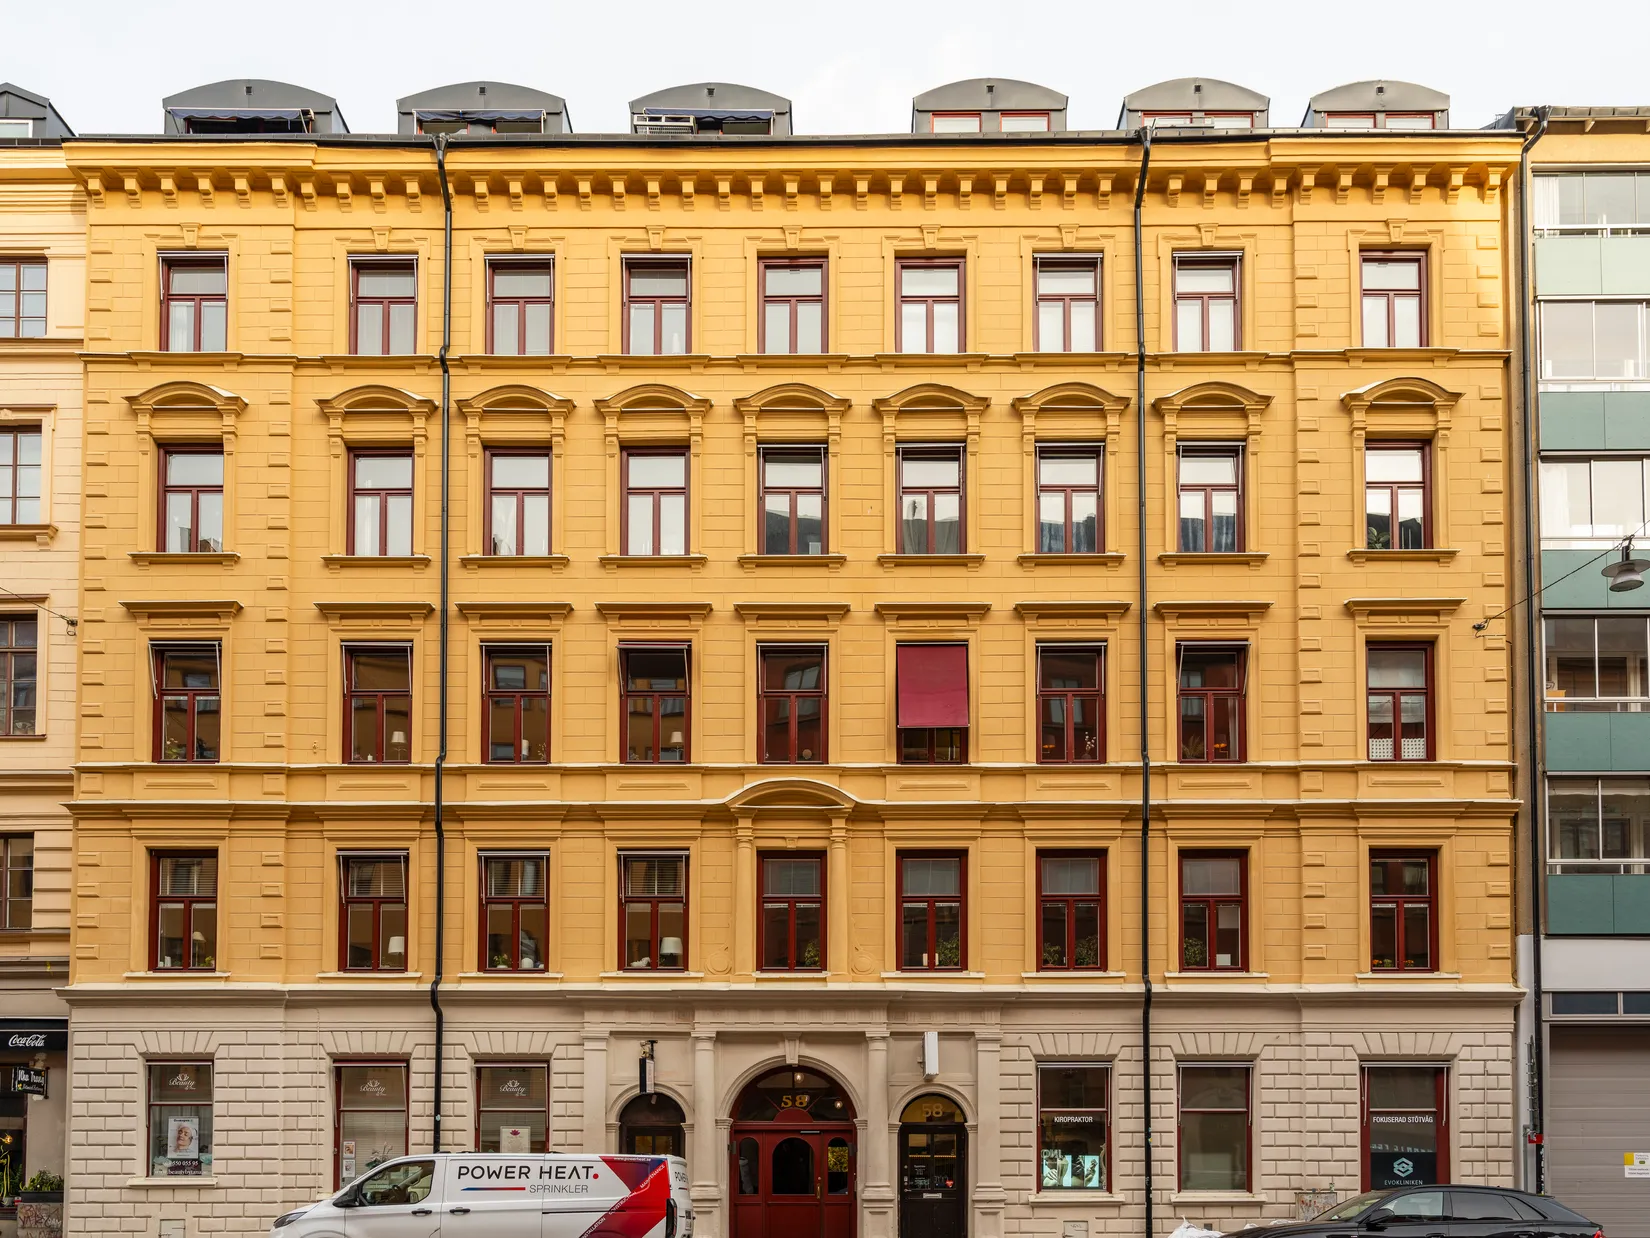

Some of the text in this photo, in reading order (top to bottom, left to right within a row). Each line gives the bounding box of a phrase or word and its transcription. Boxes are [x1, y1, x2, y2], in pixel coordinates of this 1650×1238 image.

[8, 1034, 47, 1047] Coca-Cola
[168, 1077, 196, 1088] Beauty
[360, 1084, 386, 1094] Beauty
[500, 1084, 526, 1094] Beauty
[781, 1094, 809, 1108] 58
[921, 1103, 944, 1118] 58
[457, 1165, 531, 1180] POWER
[529, 1184, 589, 1194] SPRINKLER
